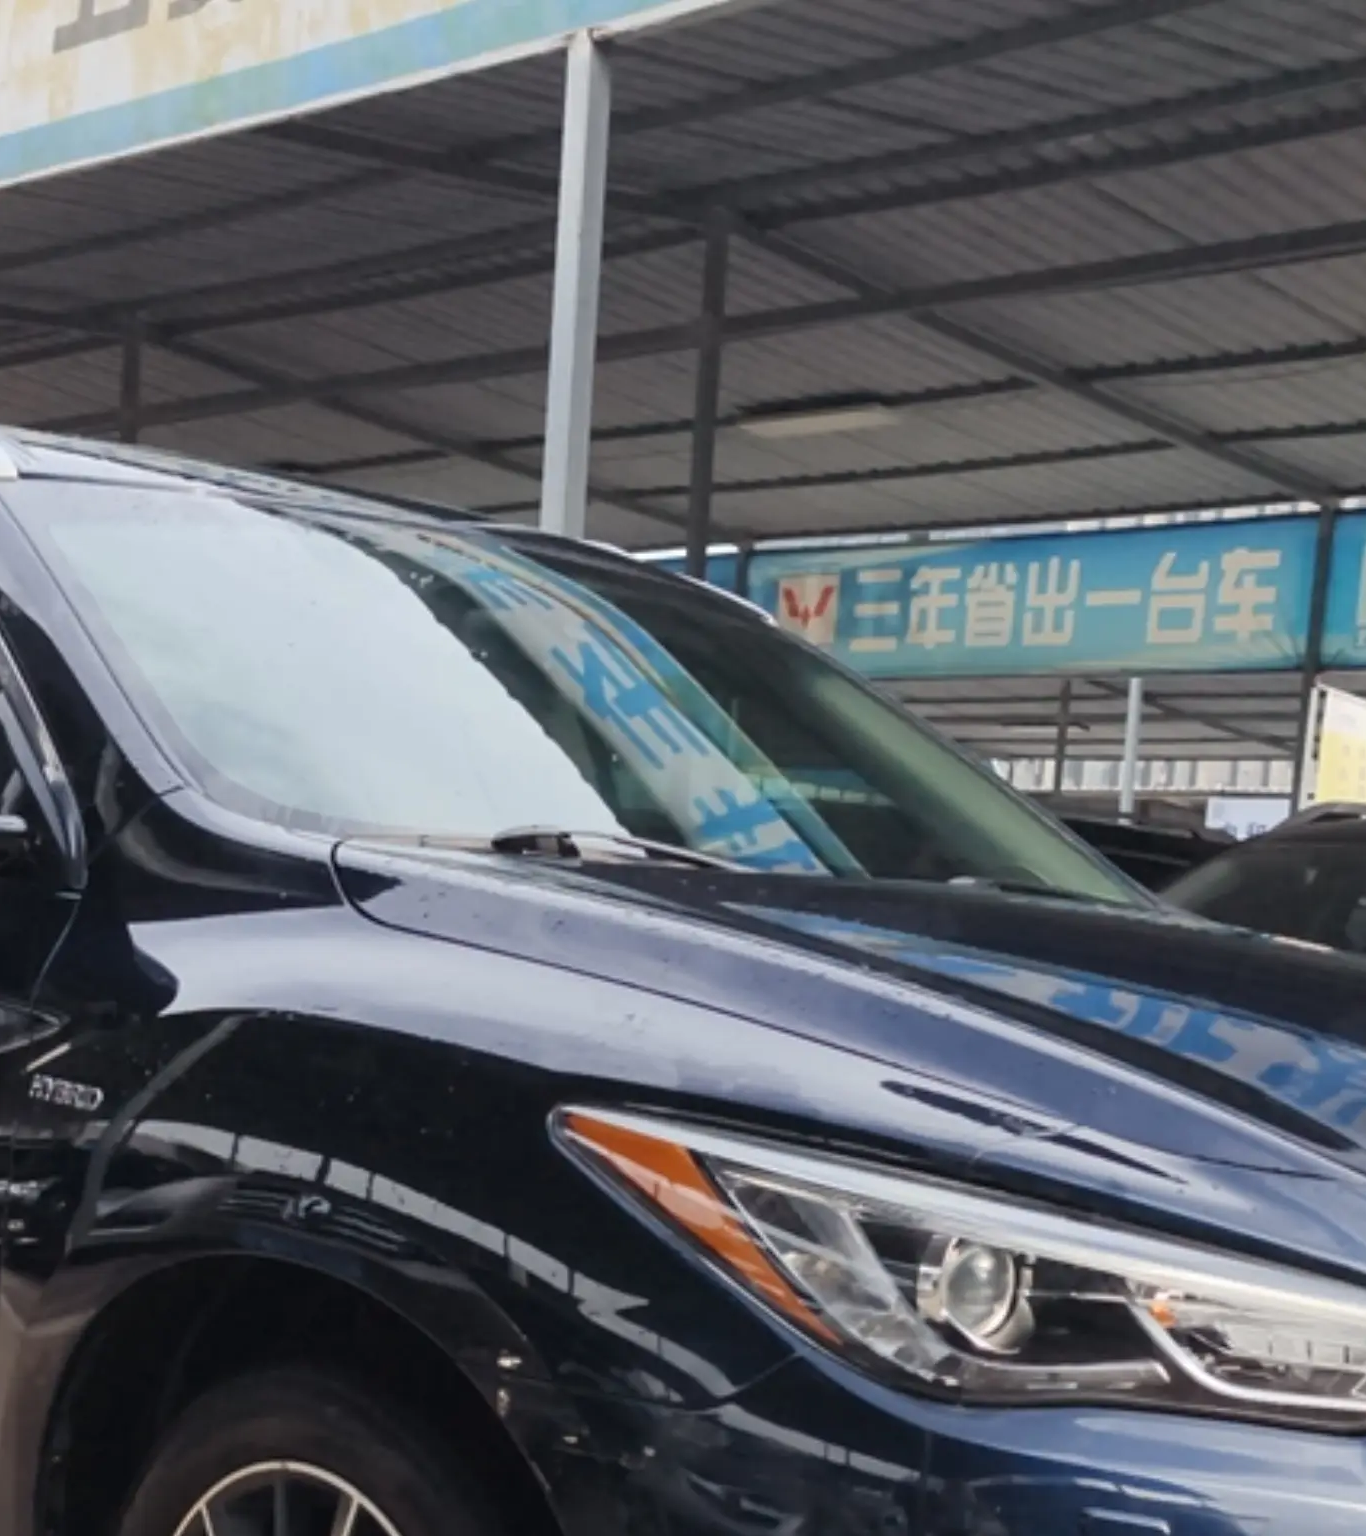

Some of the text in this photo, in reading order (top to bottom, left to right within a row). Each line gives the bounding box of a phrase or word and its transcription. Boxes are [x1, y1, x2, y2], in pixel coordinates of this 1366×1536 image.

[848, 547, 1283, 654] 三年省出一台车
